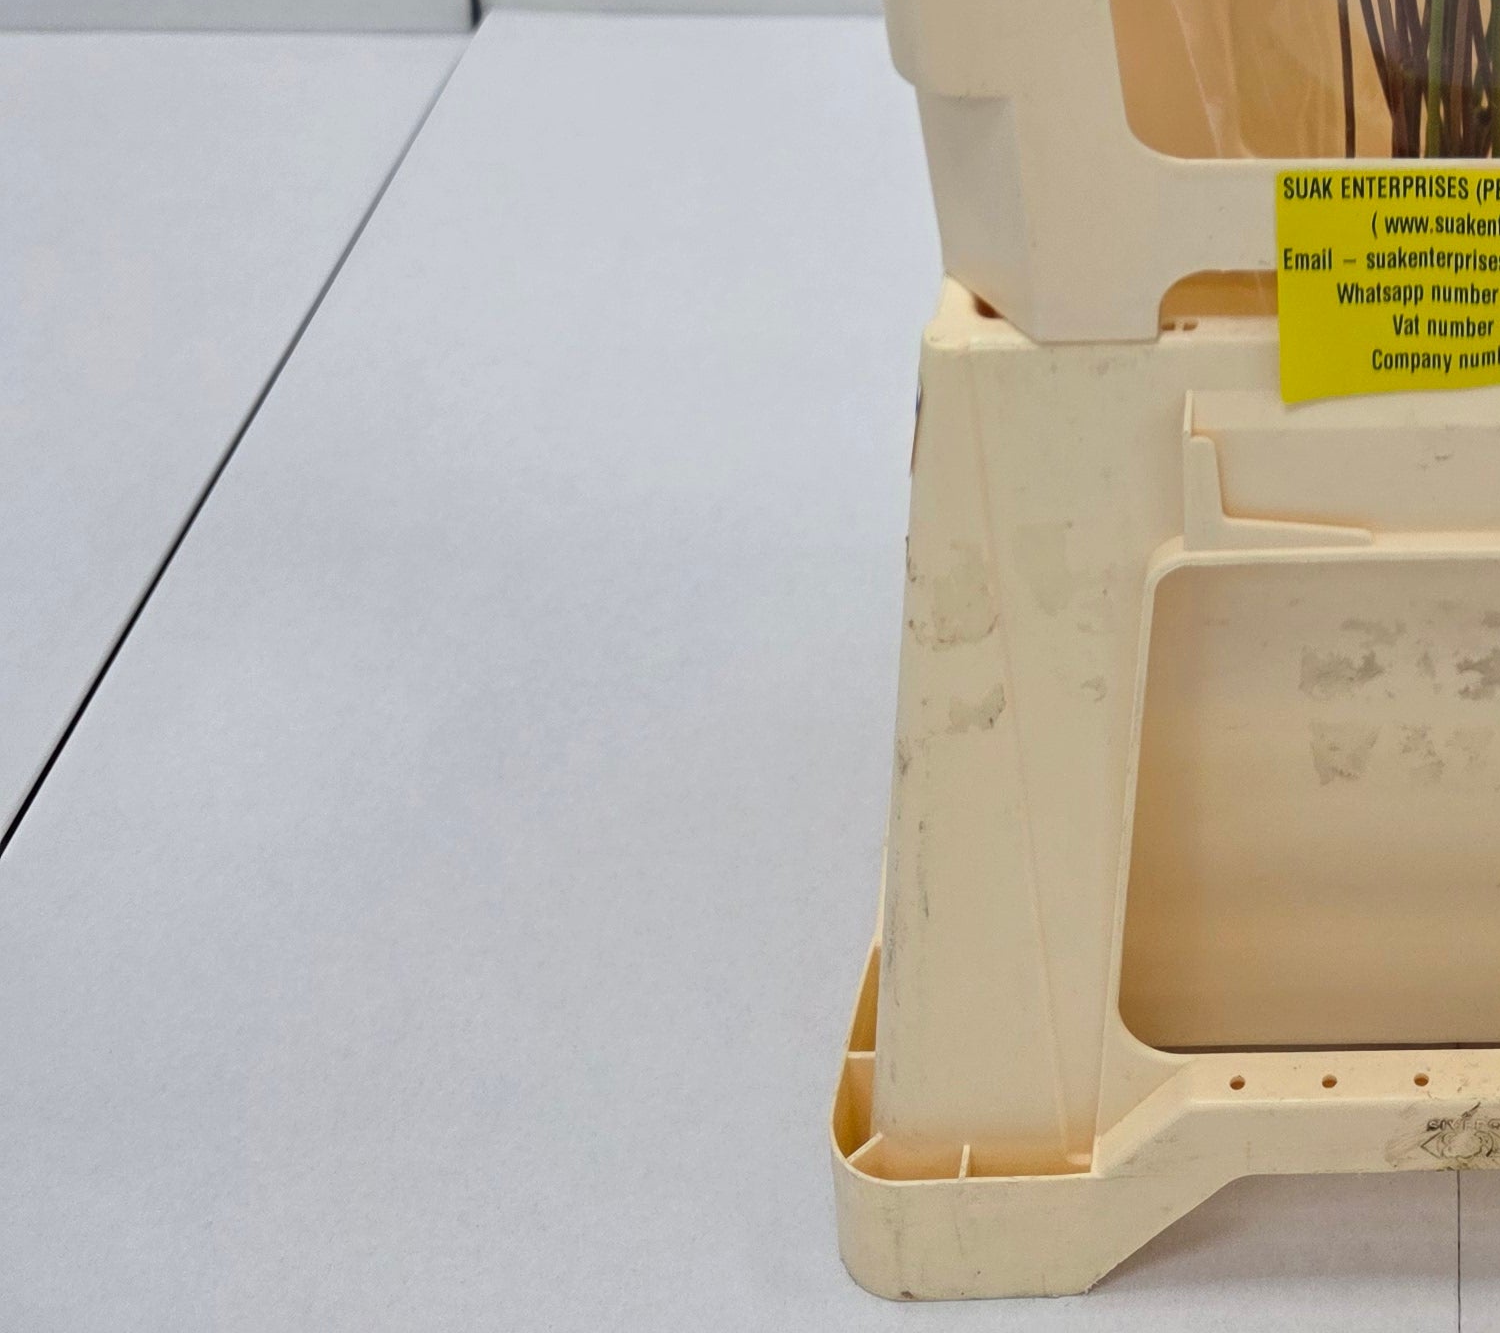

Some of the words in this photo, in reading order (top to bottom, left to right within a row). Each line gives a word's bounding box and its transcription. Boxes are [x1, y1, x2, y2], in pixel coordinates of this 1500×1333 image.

[1283, 175, 1334, 201] SUAK
[1340, 174, 1470, 201] ENTERPRISES
[1283, 246, 1333, 272] Email
[1336, 281, 1425, 308] Whatsapp
[1431, 282, 1500, 307] number
[1392, 313, 1420, 338] Vat
[1427, 315, 1495, 340] number
[1371, 348, 1453, 376] Company
